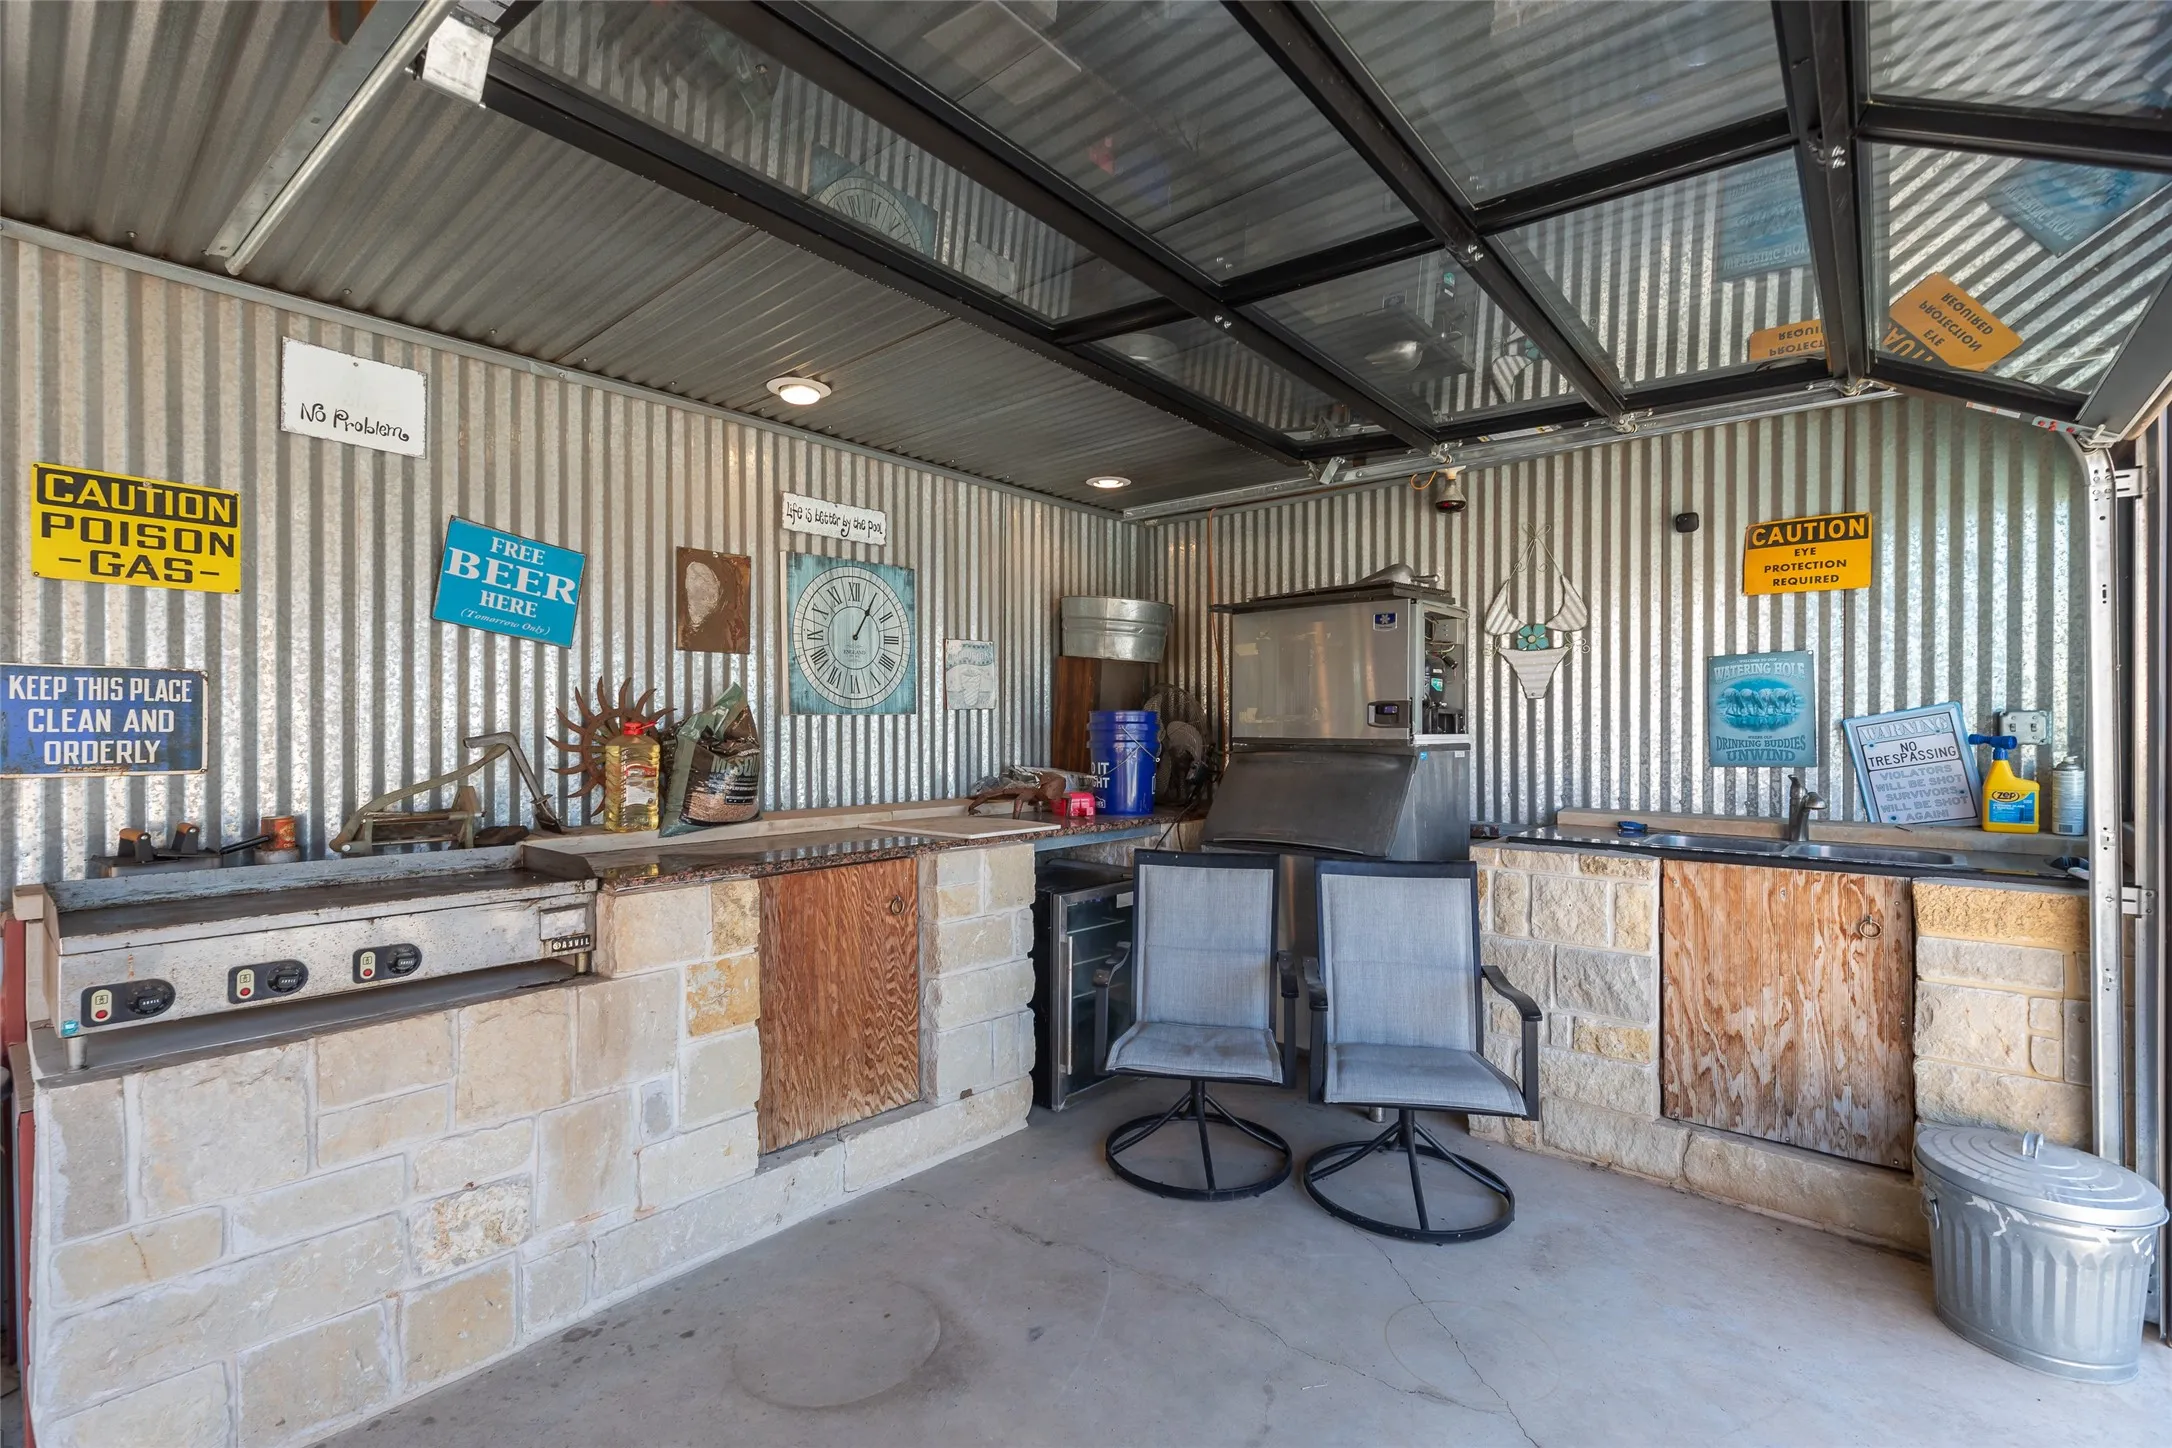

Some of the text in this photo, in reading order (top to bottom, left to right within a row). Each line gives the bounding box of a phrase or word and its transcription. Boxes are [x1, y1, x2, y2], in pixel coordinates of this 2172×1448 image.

[300, 402, 410, 441] No Problem
[44, 473, 230, 523] CAUTION
[786, 501, 803, 525] Life
[805, 507, 812, 523] is
[814, 508, 840, 527] better
[840, 515, 851, 537] by
[853, 517, 866, 531] the
[41, 511, 234, 558] POISON
[1752, 517, 1865, 546] CAUTION
[489, 536, 546, 566] FREE
[1794, 547, 1816, 556] EYE
[444, 547, 576, 605] BEER
[1764, 559, 1847, 573] PROTECTION
[1772, 574, 1839, 586] REQUIRED
[478, 589, 538, 618] HERE
[460, 607, 551, 636] (Tomorrow Only)
[1714, 662, 1805, 682] WATERING HOLE
[9, 675, 192, 702] KEEP THIS PLACE
[27, 708, 175, 733] CLEAN AND
[1860, 716, 1949, 740] WARNING
[43, 739, 161, 765] ORDERLY
[1716, 735, 1806, 751] DRINKING BUDDIES
[1726, 749, 1796, 761] UNWIND
[1900, 741, 1917, 753] NO
[1868, 746, 1956, 767] TRESPASSING
[1875, 774, 1963, 792] WILL BE SHOT
[1879, 764, 1953, 781] VIOLATORS
[1880, 796, 1968, 813] WILL BE SHOT
[1886, 786, 1958, 802] SURVIVORS
